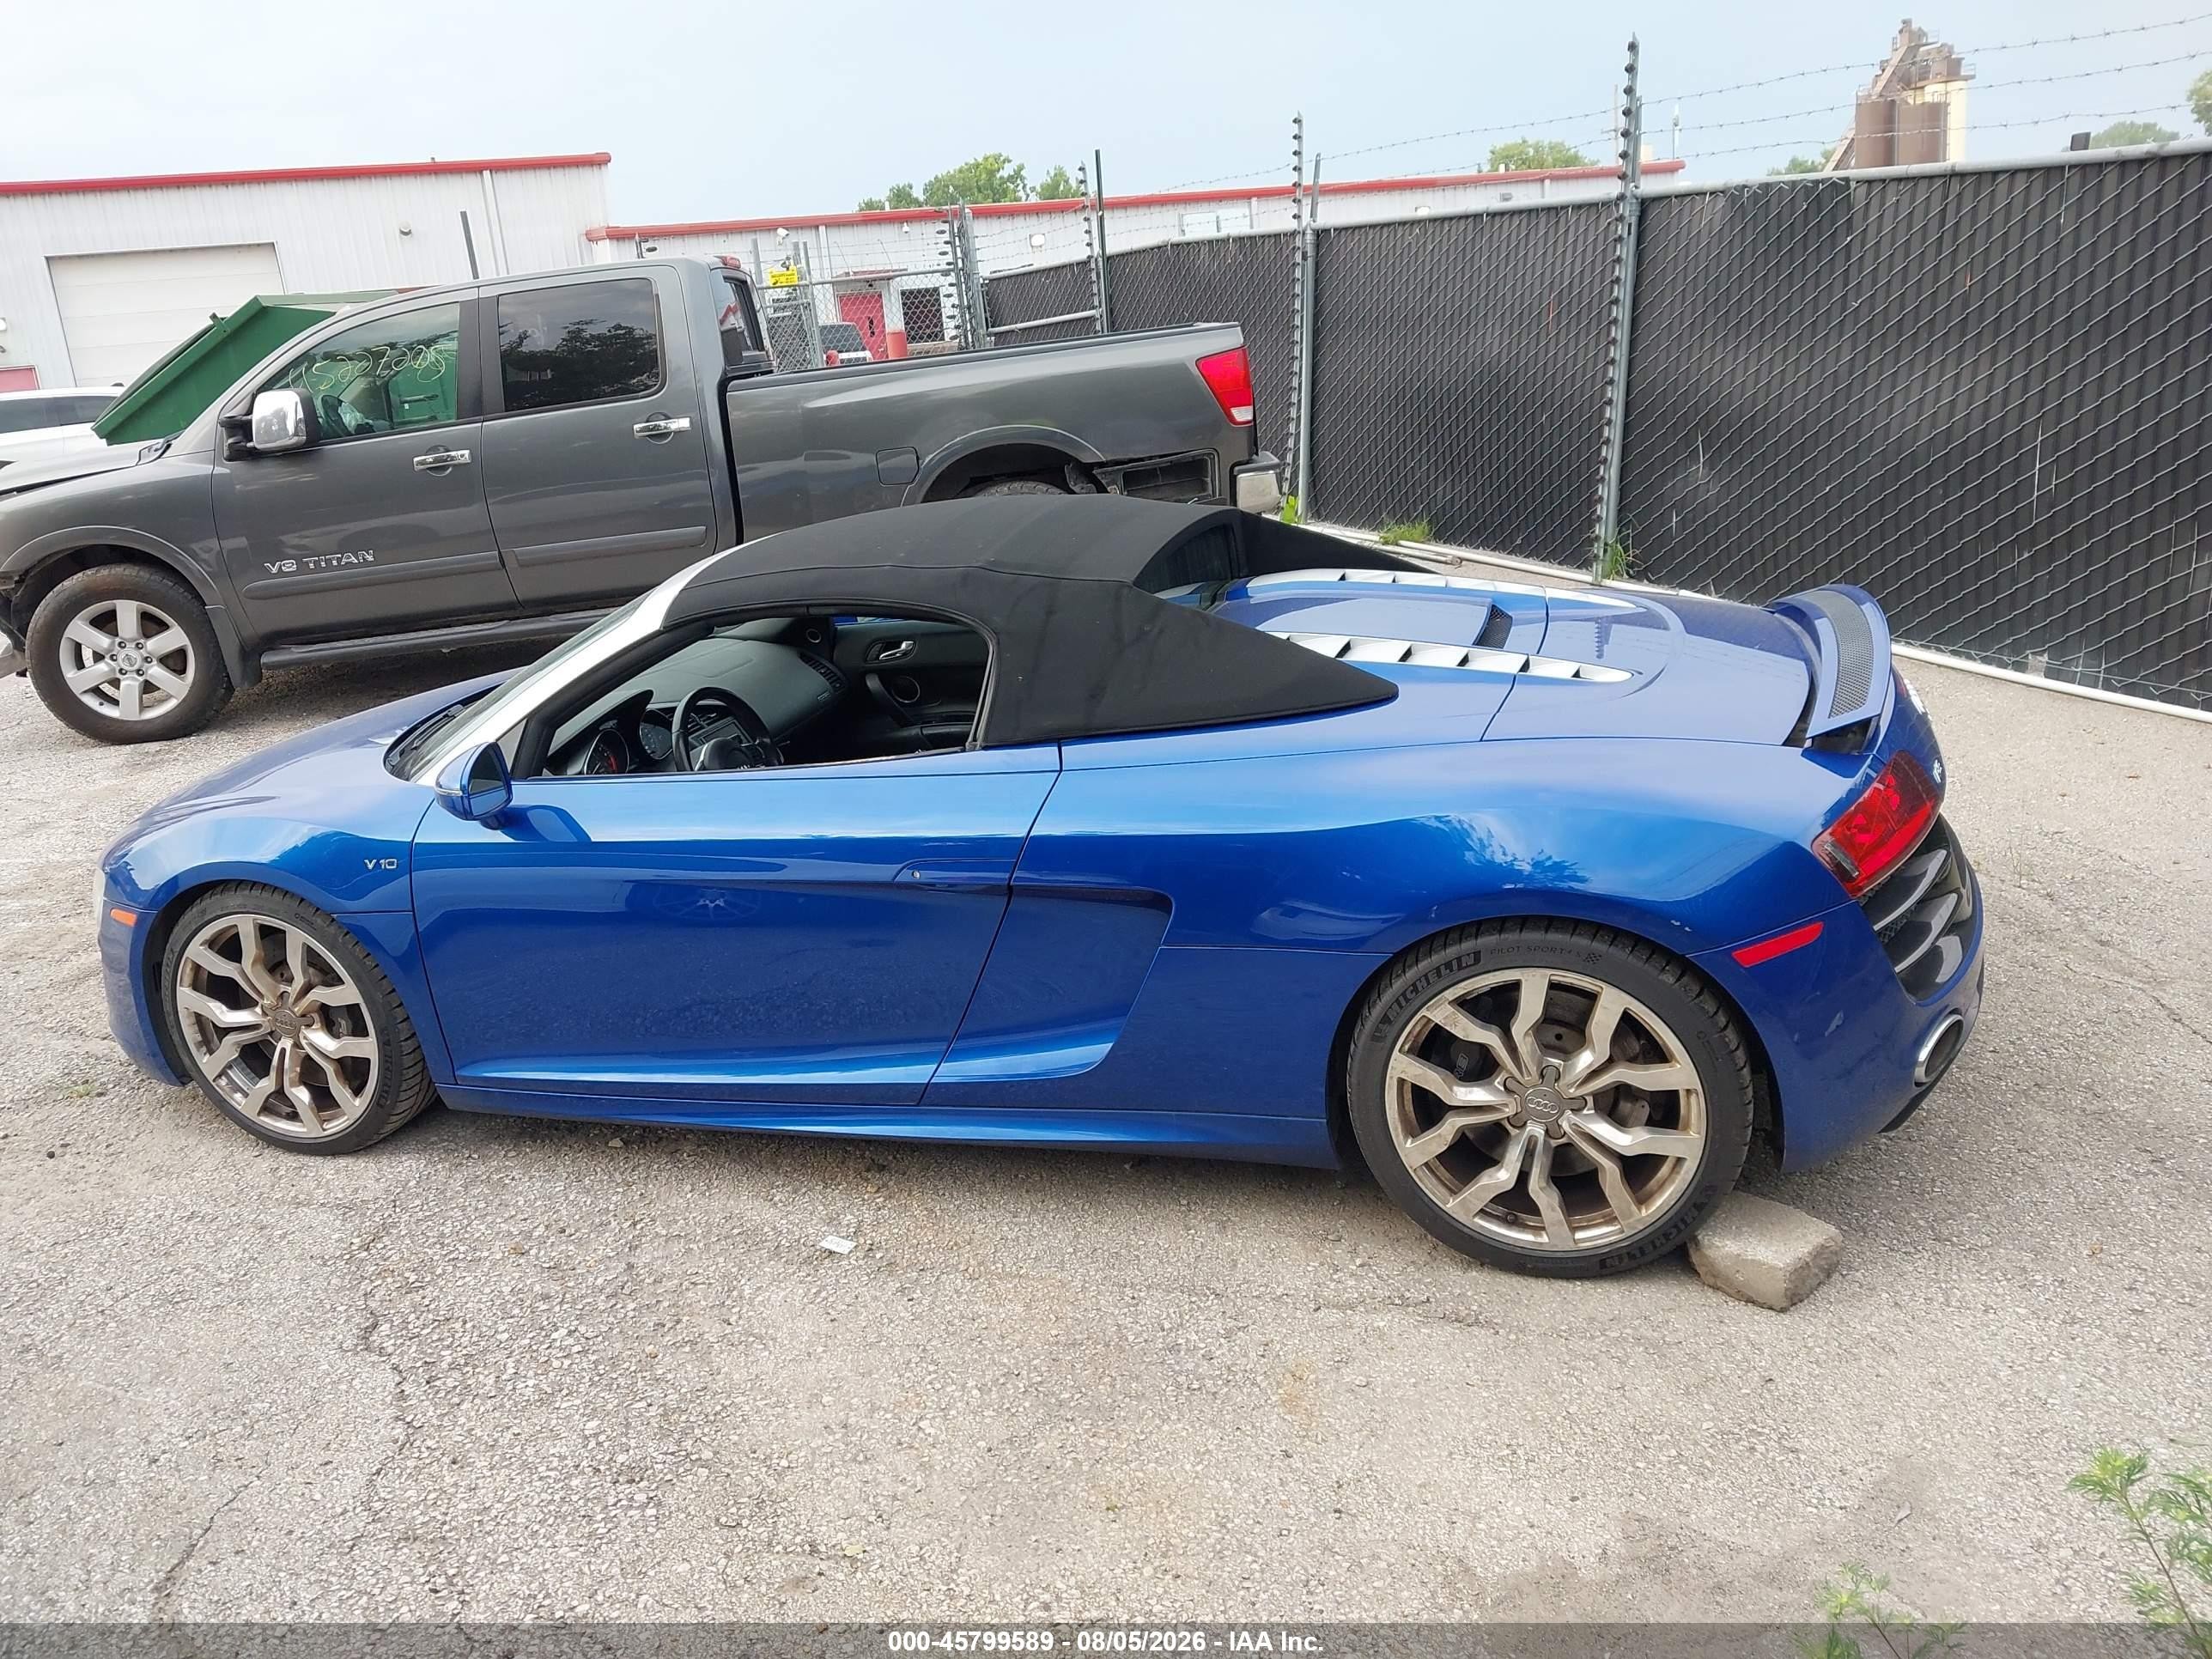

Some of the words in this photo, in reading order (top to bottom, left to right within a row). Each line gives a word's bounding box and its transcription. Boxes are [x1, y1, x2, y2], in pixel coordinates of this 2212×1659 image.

[264, 560, 297, 574] V8
[302, 550, 375, 569] TITAN
[363, 859, 398, 870] V10
[1490, 945, 1521, 955] PILOT
[1526, 945, 1564, 954] SPORT
[1387, 953, 1474, 1021] MICHELIN
